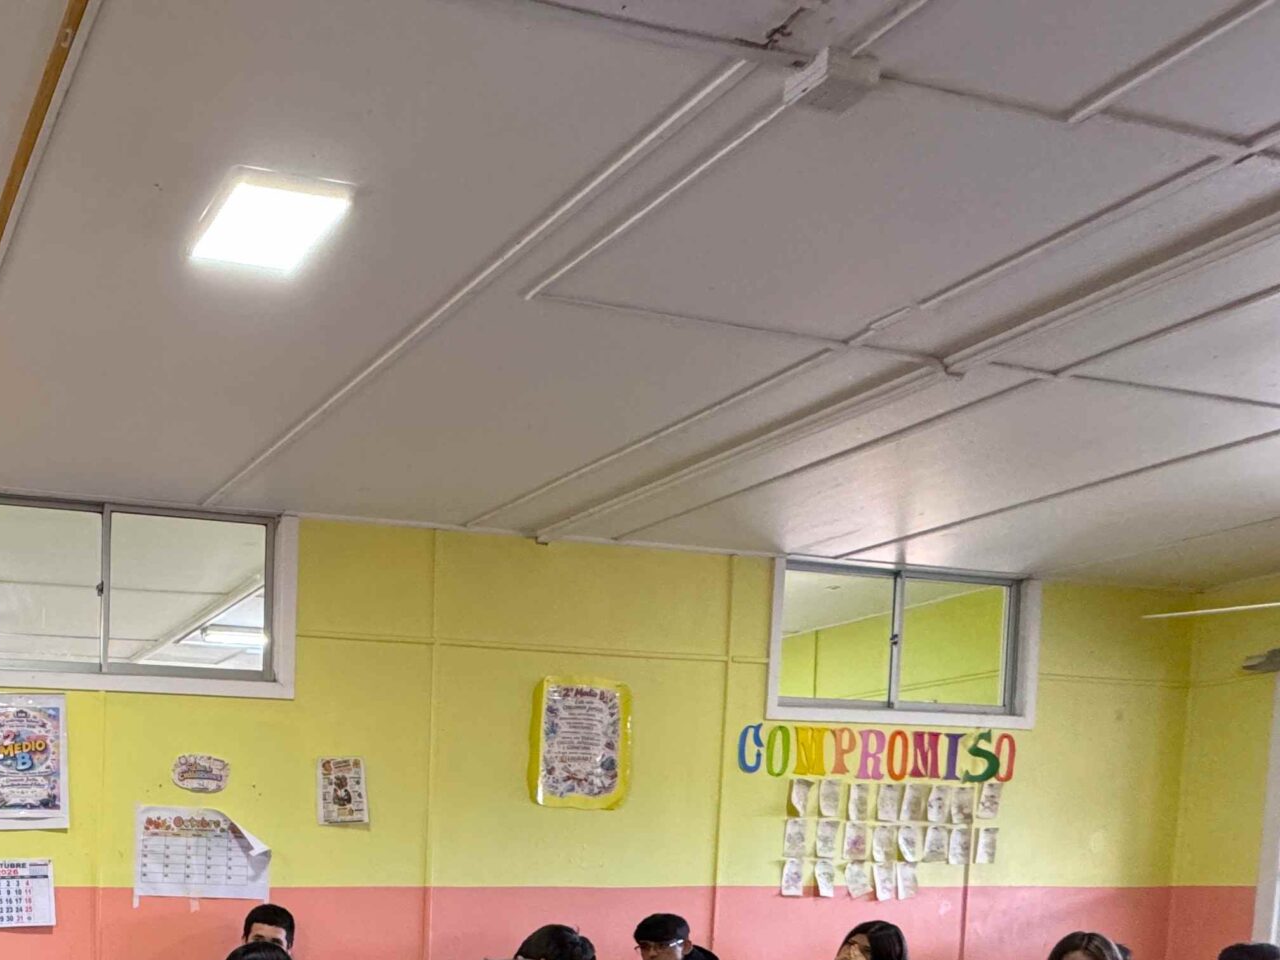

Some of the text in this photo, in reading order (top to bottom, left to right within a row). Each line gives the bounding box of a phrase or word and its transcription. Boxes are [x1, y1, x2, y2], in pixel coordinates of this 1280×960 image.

[0, 740, 46, 757] MEDIO
[737, 723, 1016, 783] COMPROMISO
[16, 752, 33, 771] B
